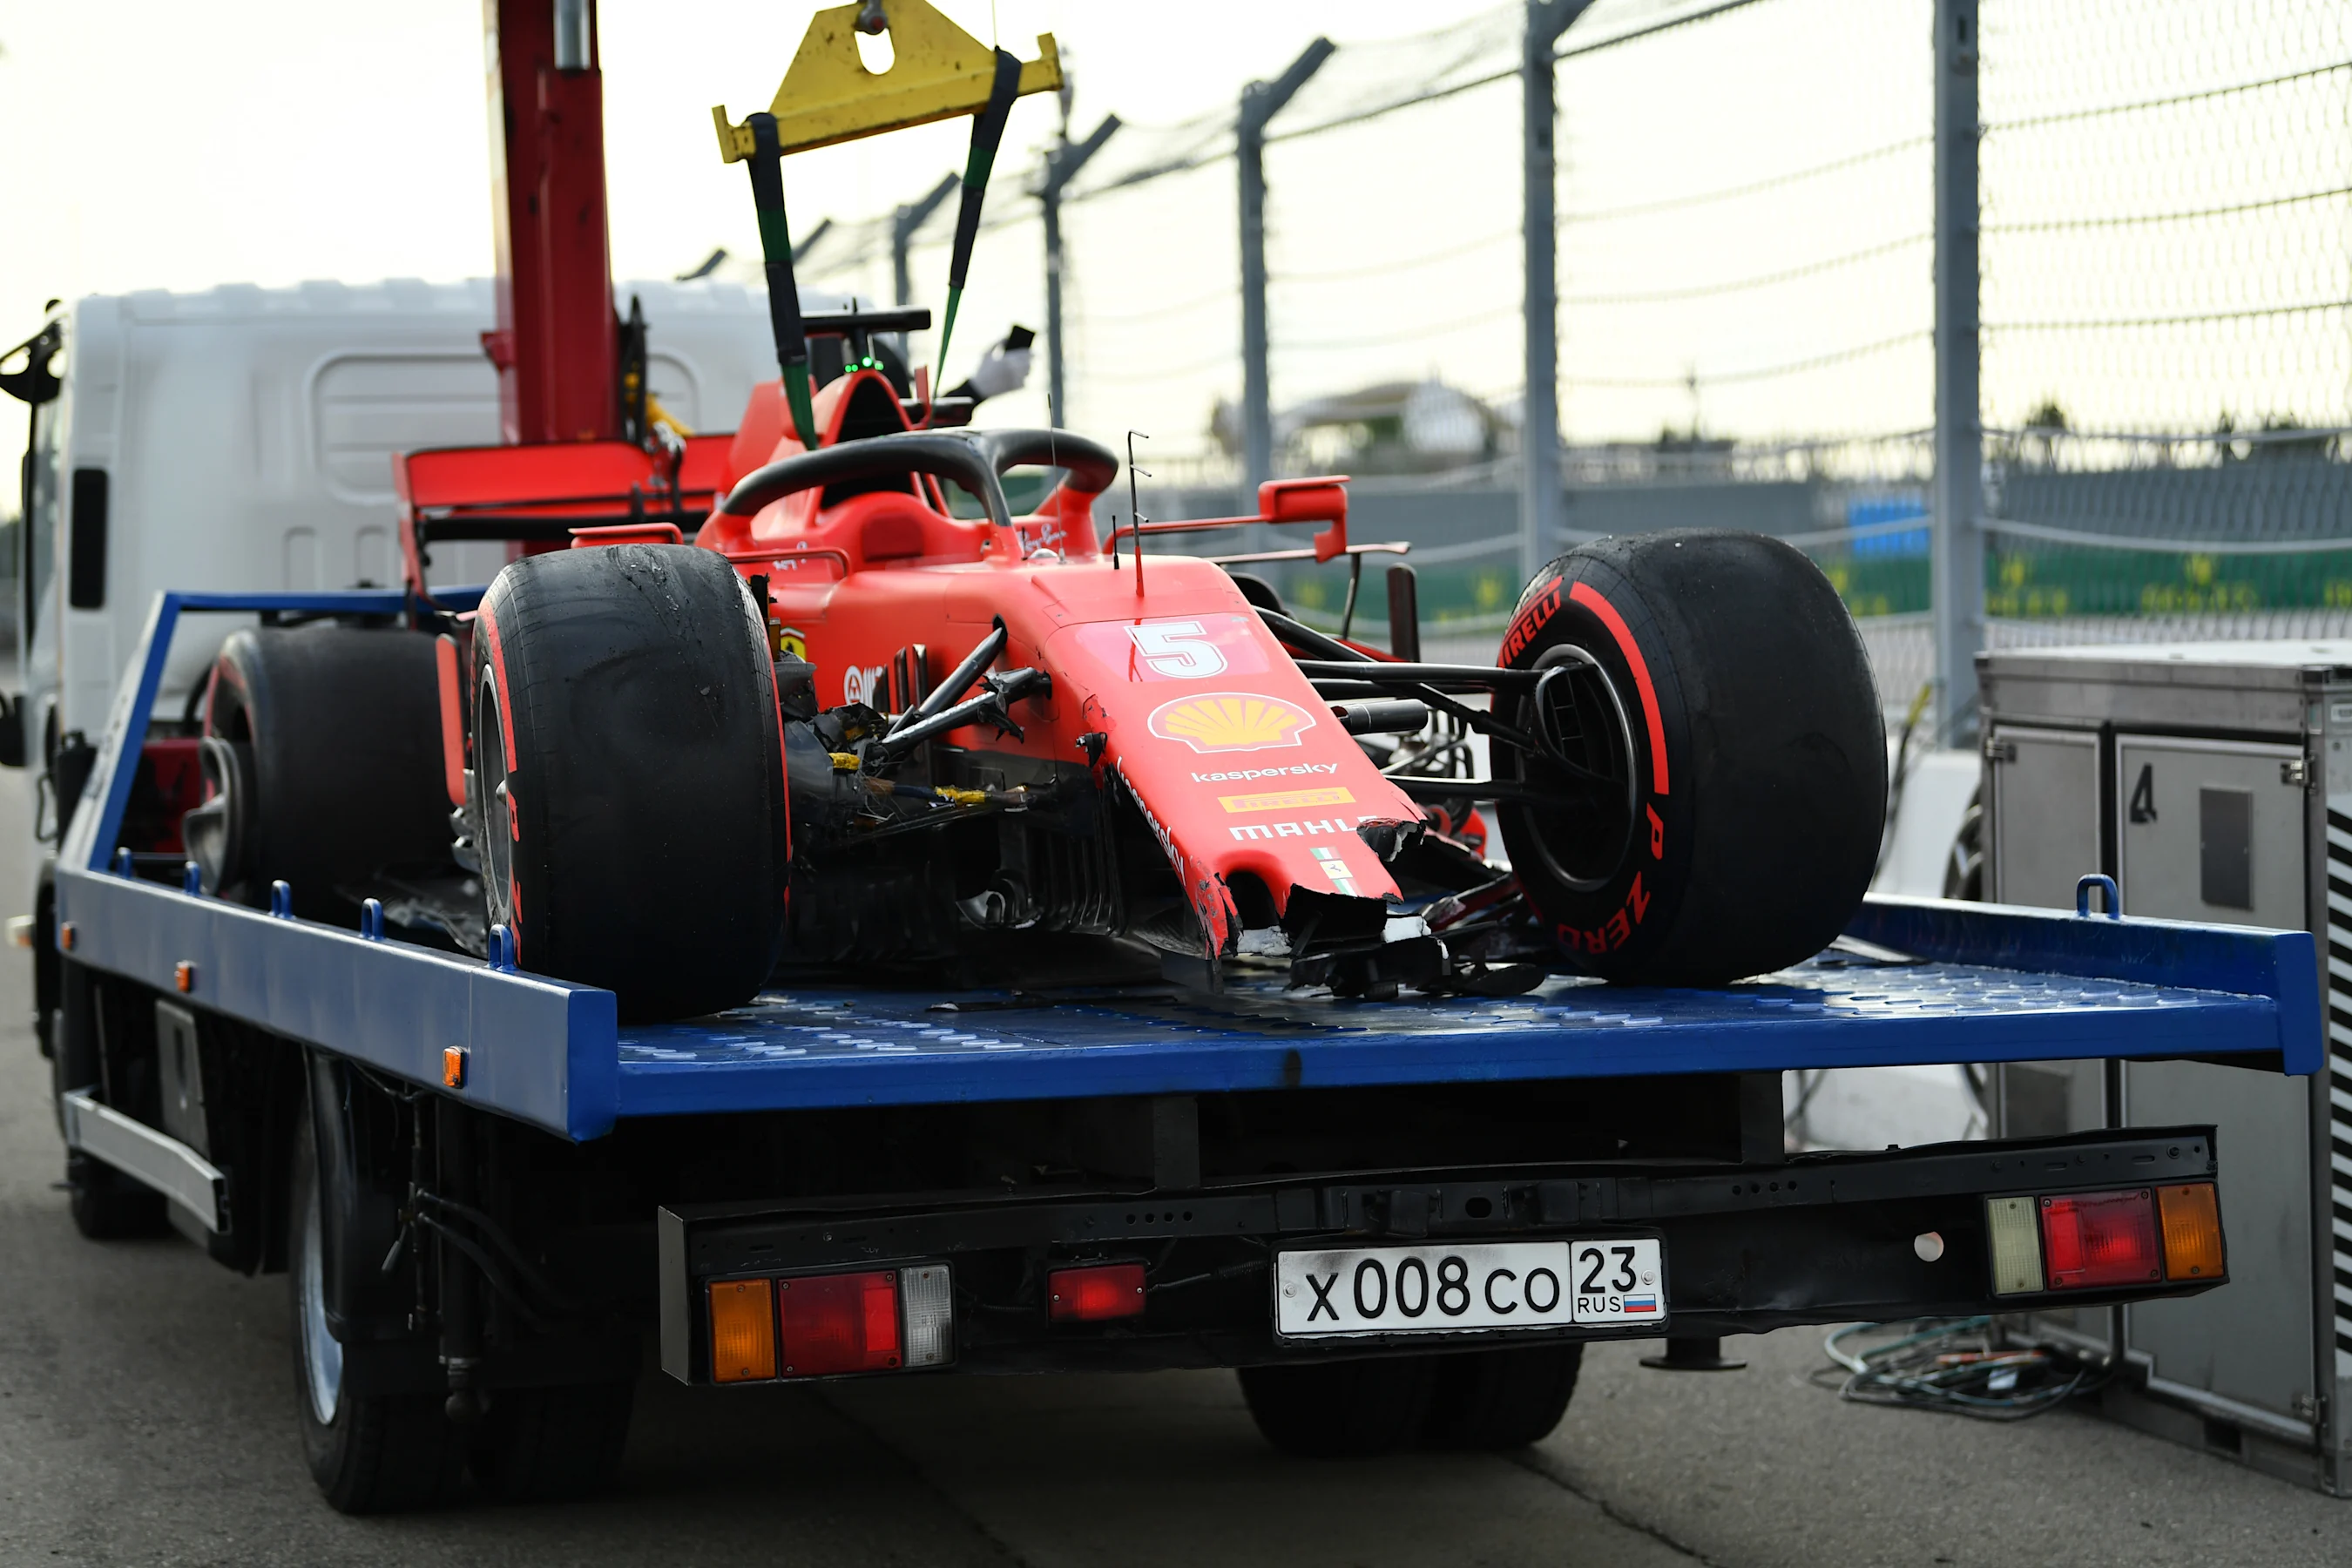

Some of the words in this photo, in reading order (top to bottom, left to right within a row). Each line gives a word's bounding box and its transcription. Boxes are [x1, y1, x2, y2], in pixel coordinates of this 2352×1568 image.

[1124, 621, 1228, 679] 5
[1191, 763, 1338, 782] kaspersky
[2129, 761, 2158, 824] 4
[1231, 791, 1342, 809] PIRELLI
[1646, 802, 1664, 860] P
[1558, 871, 1651, 955] ZERO
[1579, 1247, 1637, 1294] 23
[1578, 1296, 1621, 1314] RUS
